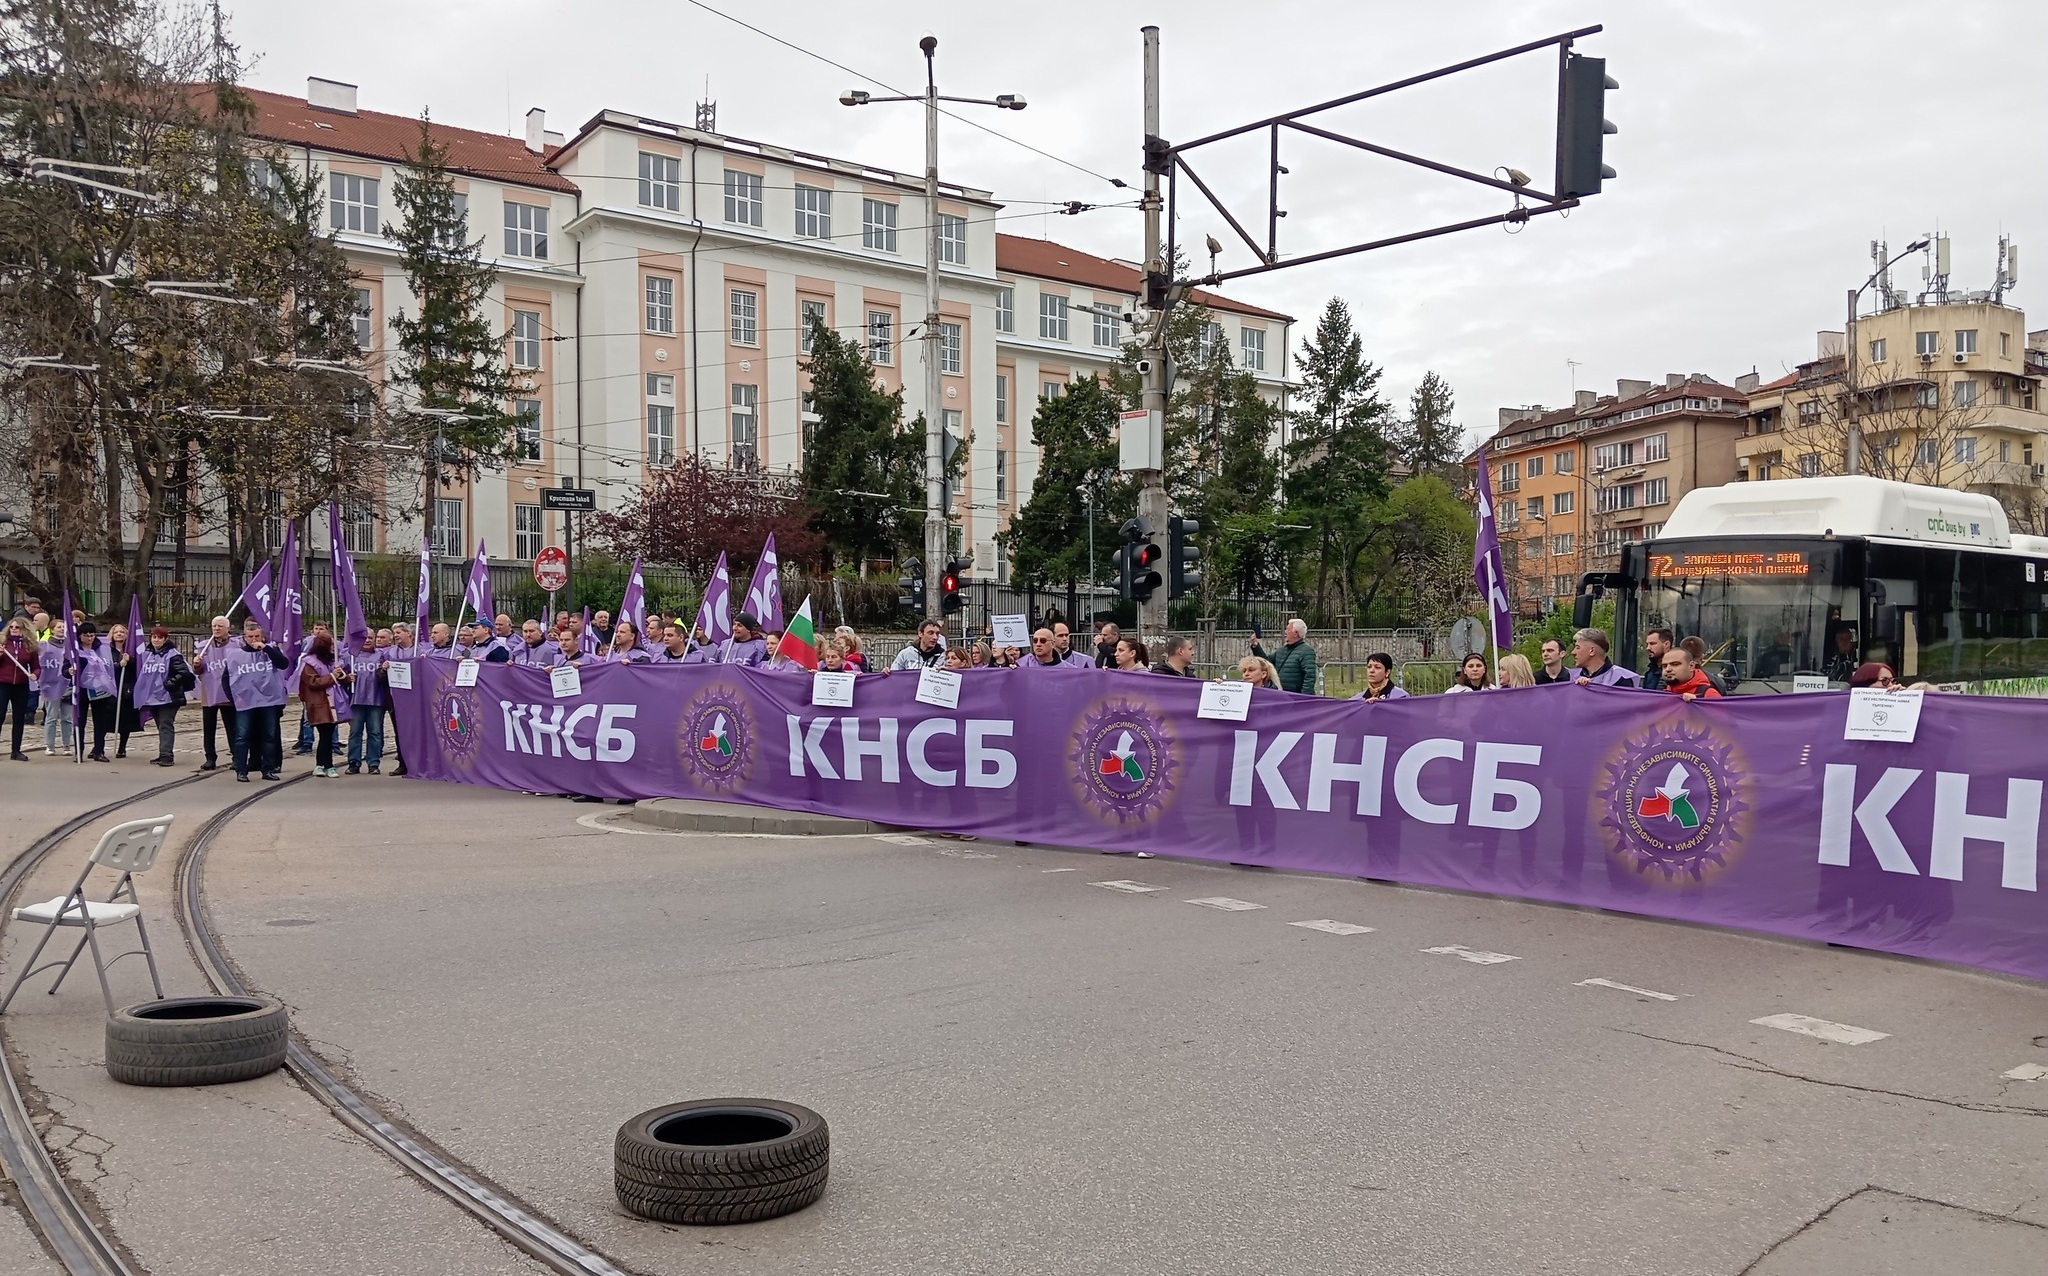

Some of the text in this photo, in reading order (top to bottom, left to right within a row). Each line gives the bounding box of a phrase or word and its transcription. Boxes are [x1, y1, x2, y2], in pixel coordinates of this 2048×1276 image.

[1928, 518, 1944, 532] CNG
[1945, 520, 1958, 533] bus
[1958, 522, 1966, 537] by
[1649, 555, 1673, 577] 72
[500, 700, 637, 762] КНСБ
[1090, 742, 1097, 752] НА
[1096, 721, 1142, 742] НЕЗАВИСИМИТЕ
[786, 714, 1018, 788] КНСБ
[1140, 730, 1158, 771] СИНДИКАТИ
[1638, 750, 1700, 776] НЕЗАВИСИМИТЕ
[1089, 753, 1119, 799] КОНФЕДЕРАЦИЯ
[1126, 777, 1154, 800] БЪЛГАРИЯ
[1229, 729, 1544, 830] КНСБ
[1630, 776, 1640, 788] НА
[1700, 762, 1719, 816] СИНДИКАТИ
[1626, 788, 1664, 850] КОНФЕДЕРАЦИЯ
[1818, 763, 2044, 892] КН
[1675, 824, 1712, 852] БЪЛГАРИЯ
